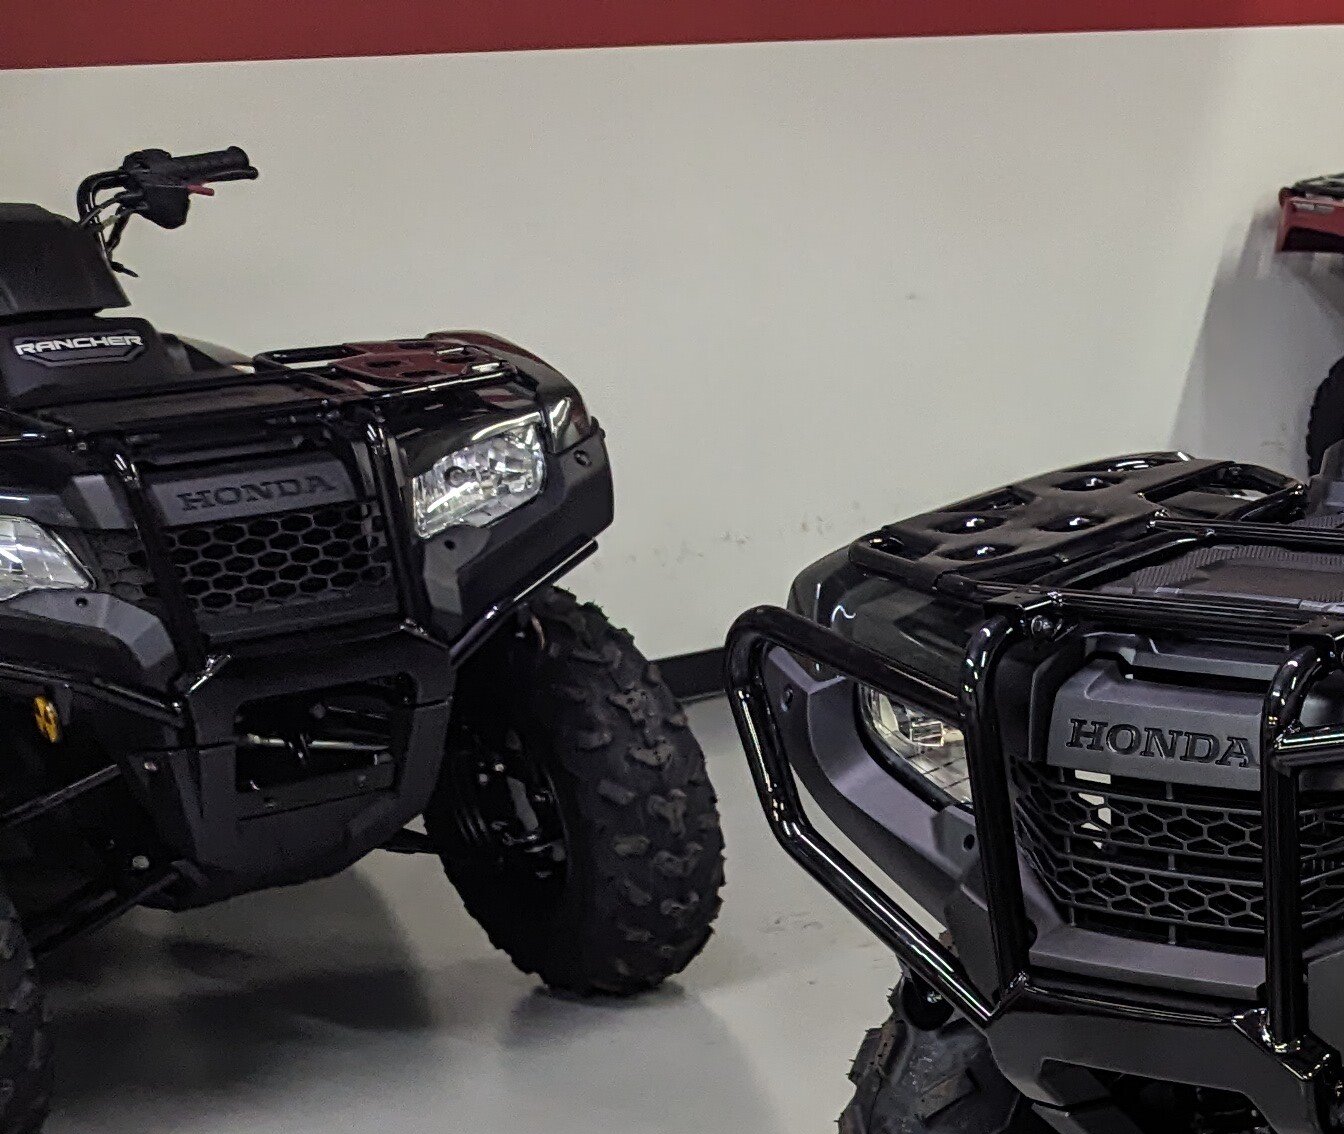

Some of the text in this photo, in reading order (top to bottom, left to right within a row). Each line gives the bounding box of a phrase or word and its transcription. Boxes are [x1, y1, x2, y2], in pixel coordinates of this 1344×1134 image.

[14, 335, 144, 356] RANCHER
[176, 474, 338, 511] HONDA
[1065, 718, 1258, 768] HONDA
